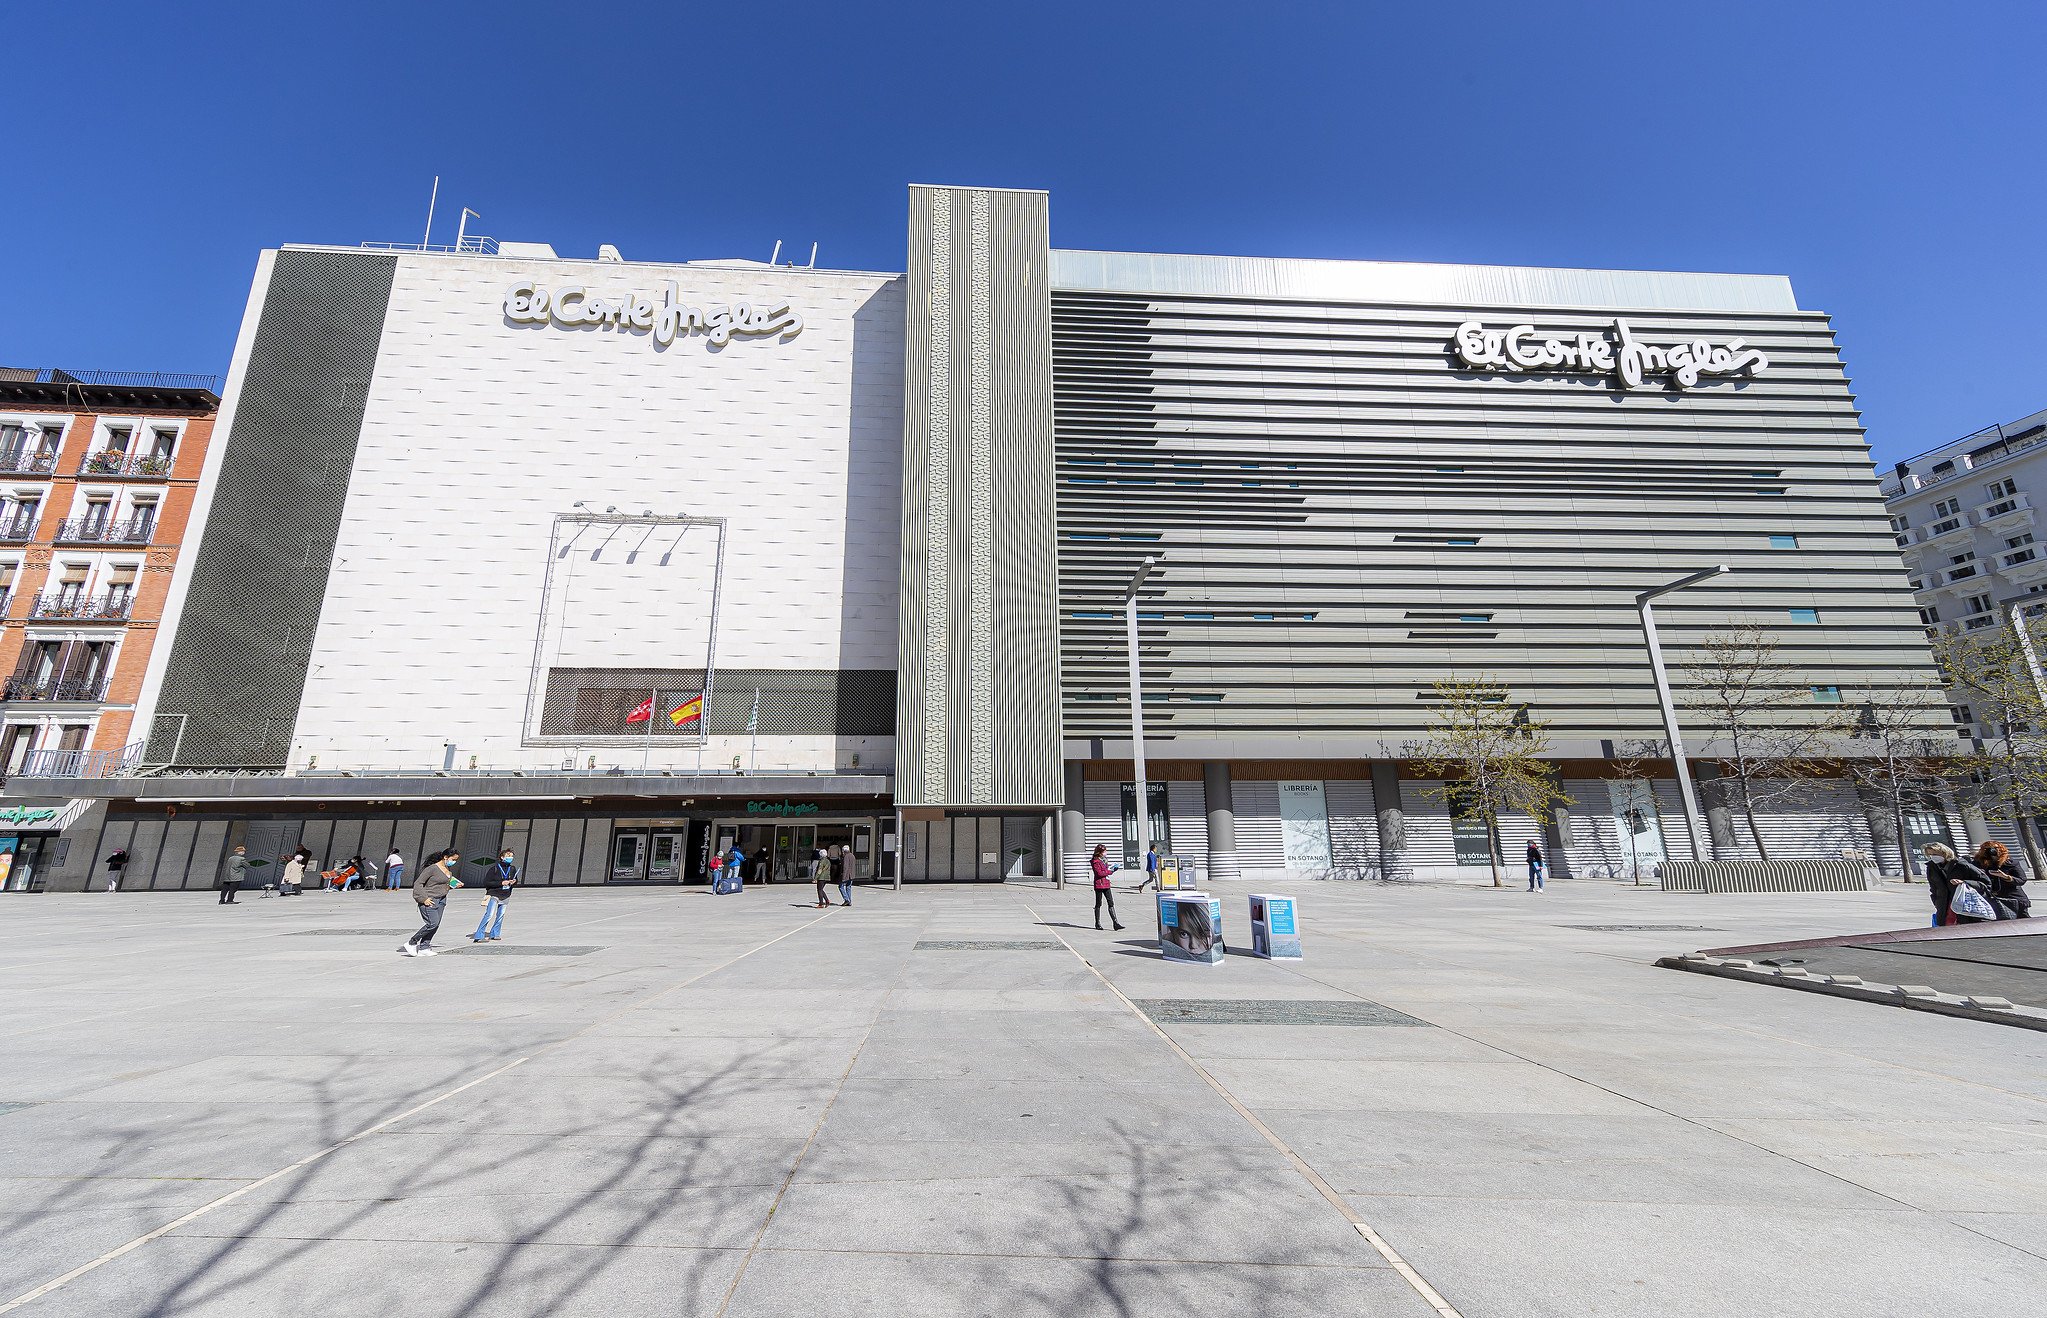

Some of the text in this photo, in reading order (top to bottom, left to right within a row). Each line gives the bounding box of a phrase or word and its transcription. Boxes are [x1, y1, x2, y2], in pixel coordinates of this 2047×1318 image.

[504, 280, 804, 346] El Corte Inglés
[1454, 318, 1769, 389] El Corte Inglés
[1122, 784, 1165, 792] PAPERÍA
[1283, 784, 1319, 792] LIBRERÍA
[747, 801, 758, 813] El
[758, 801, 783, 813] Corte
